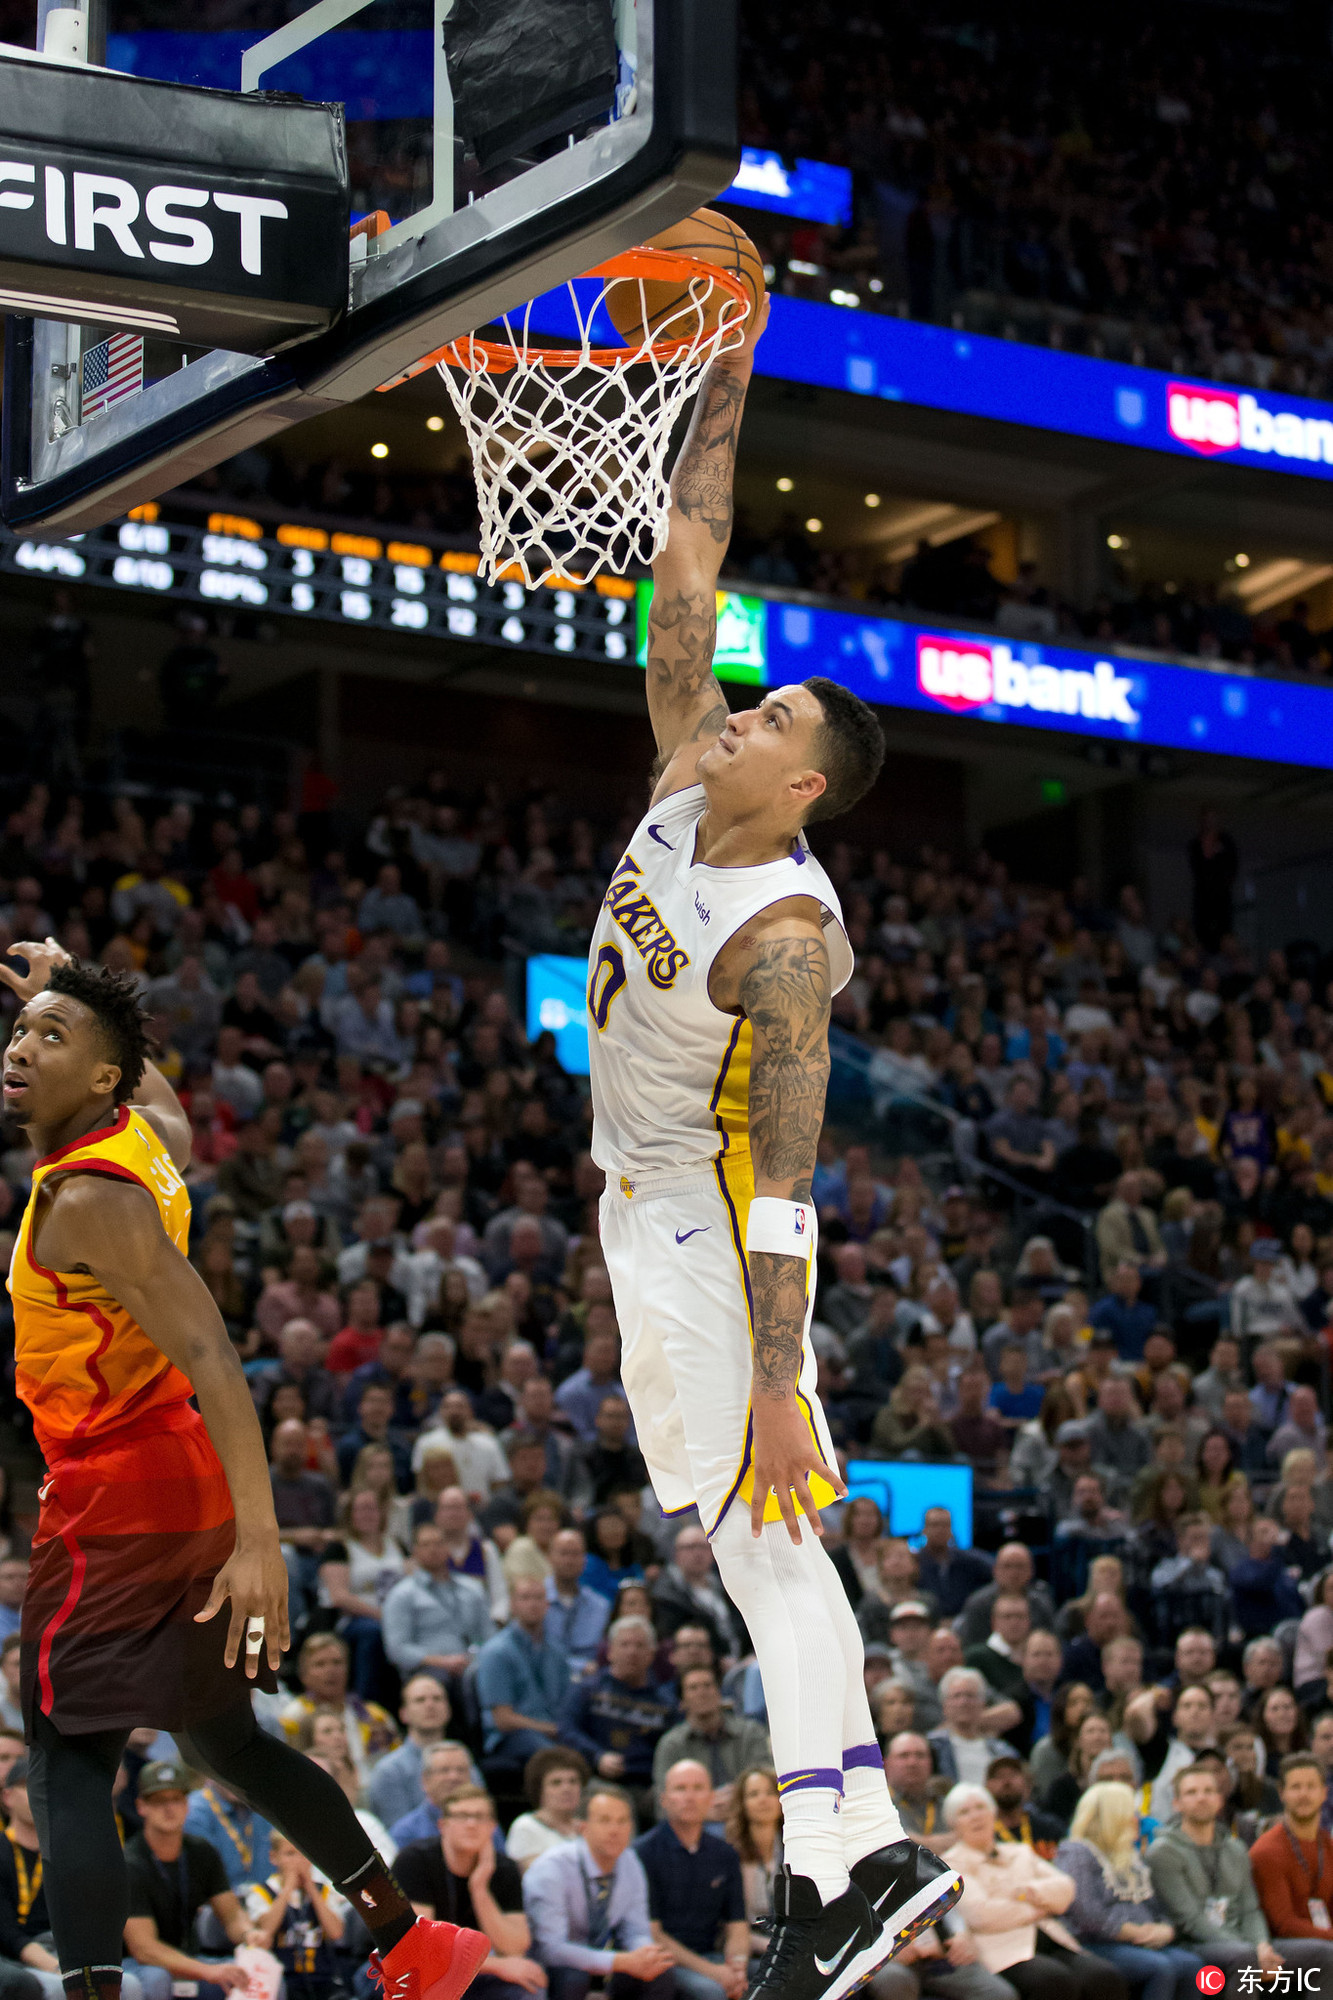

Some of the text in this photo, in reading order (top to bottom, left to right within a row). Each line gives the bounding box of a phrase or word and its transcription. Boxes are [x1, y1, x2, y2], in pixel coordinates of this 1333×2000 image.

[603, 853, 691, 991] LAKERS
[694, 890, 711, 926] wish
[587, 941, 627, 1033] 0
